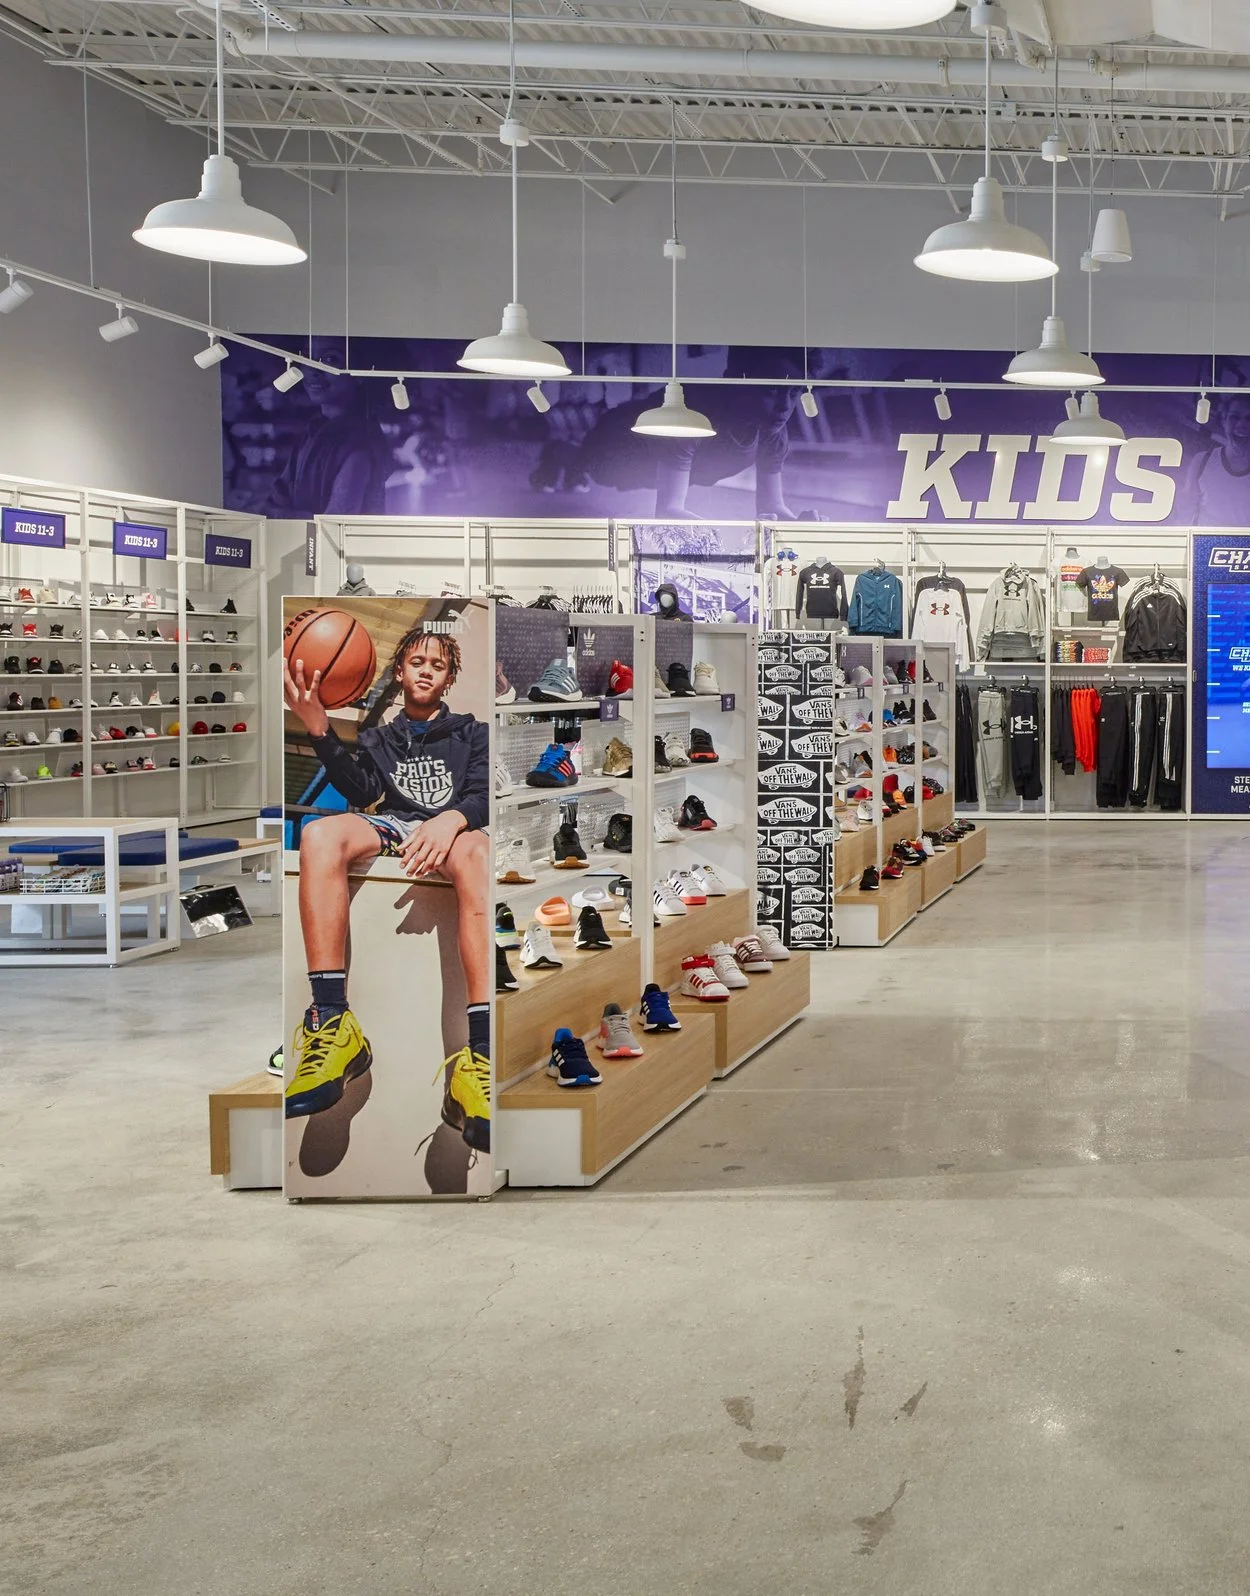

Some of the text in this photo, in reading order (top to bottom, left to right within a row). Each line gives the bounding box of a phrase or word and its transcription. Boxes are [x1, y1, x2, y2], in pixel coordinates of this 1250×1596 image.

[886, 433, 1183, 522] KIDS
[14, 521, 55, 537] KIDS 11-3
[124, 534, 158, 548] KIDS 11-3
[215, 546, 244, 558] KIDS 11-3
[423, 620, 465, 634] PUMA
[809, 701, 832, 709] VANS
[798, 708, 830, 718] OFF THE
[808, 735, 831, 743] VANS
[812, 743, 828, 752] THE
[774, 766, 798, 775] VANS
[395, 771, 453, 793] VISION
[763, 773, 813, 784] OFF THE WALL
[774, 801, 797, 809] VANS
[763, 807, 813, 818] OFF THE WALL
